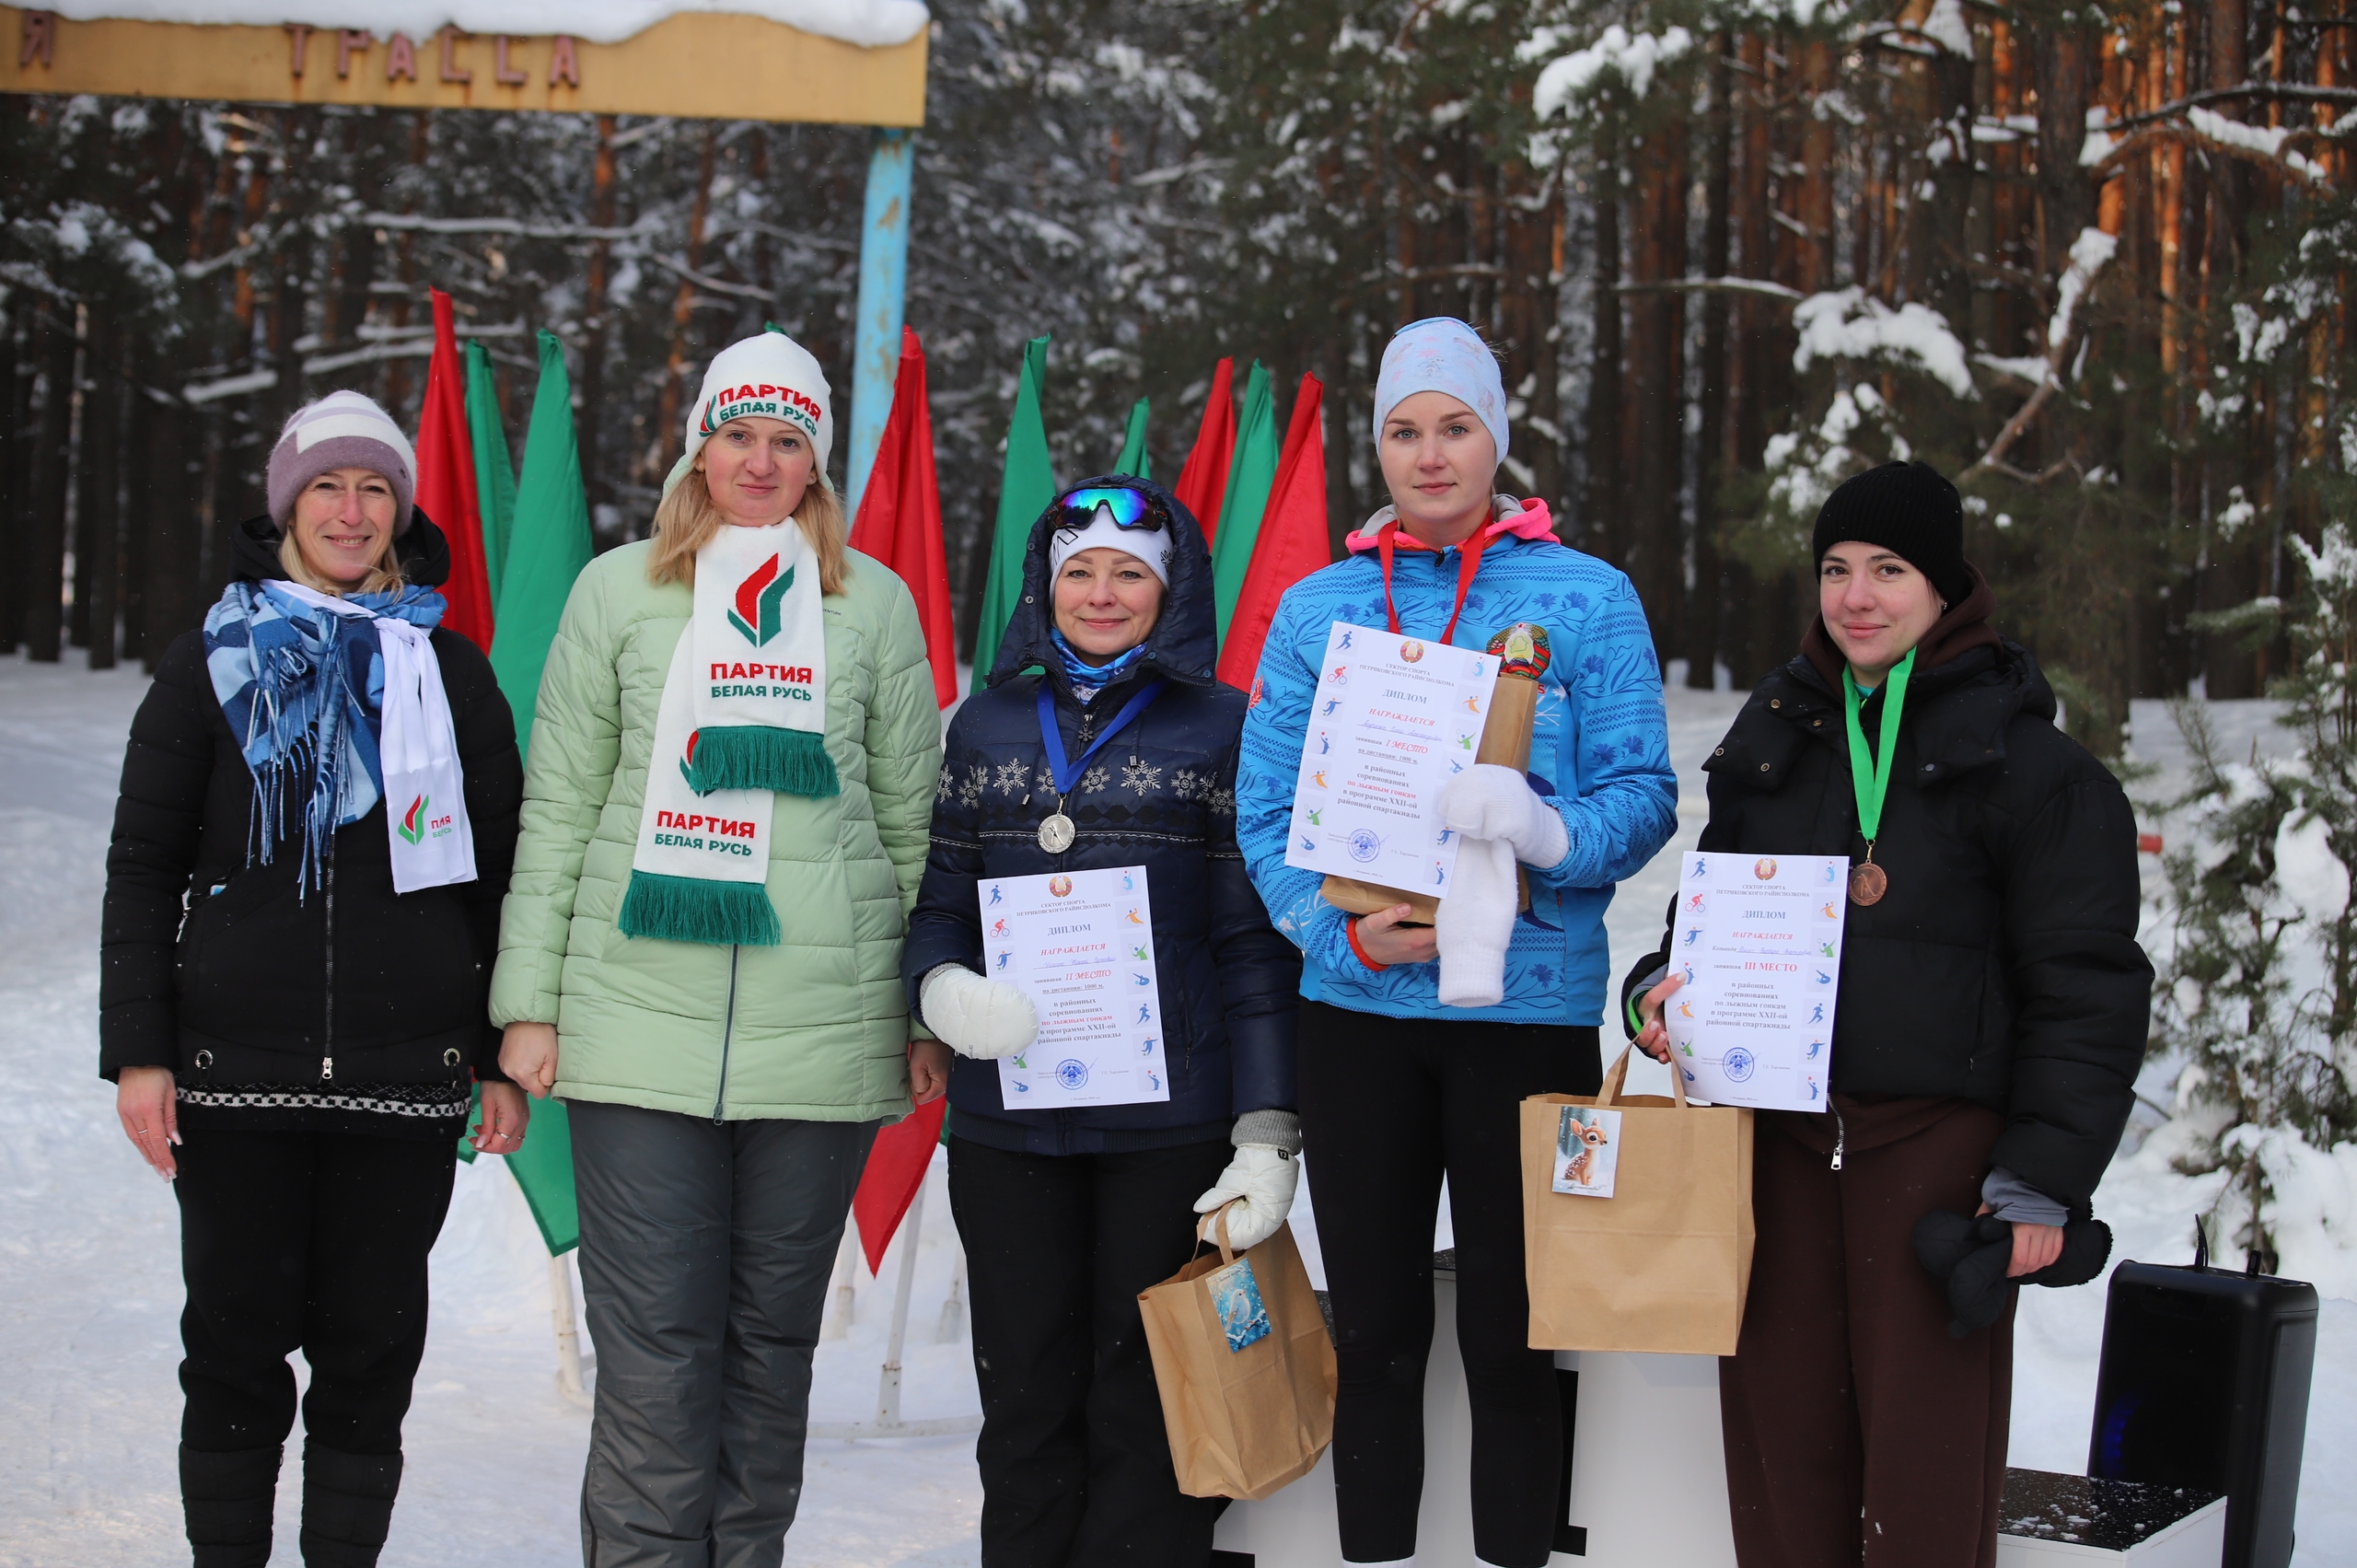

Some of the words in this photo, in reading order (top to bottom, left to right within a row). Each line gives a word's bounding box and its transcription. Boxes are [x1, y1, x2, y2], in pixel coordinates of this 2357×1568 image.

[719, 384, 821, 423] ПАРТИЯ
[719, 402, 776, 422] БЕЛАЯ
[783, 405, 818, 436] РУСЬ
[711, 663, 812, 684] ПАРТИЯ
[1359, 664, 1407, 678] ПЕТРИКОВСКОГО
[1386, 663, 1408, 671] СЕКТОР
[1408, 668, 1431, 676] СПОРТА
[711, 685, 767, 699] БЕЛАЯ
[772, 686, 812, 702] РУСЬ
[1382, 689, 1427, 704] ДИПЛОМ
[1368, 708, 1435, 726] НАГРАЖДАЕТСЯ
[1391, 740, 1428, 754] МЕСТО
[1370, 766, 1406, 778] районных
[1357, 773, 1410, 788] соревнованиях
[1356, 782, 1389, 794] лыжным
[1390, 789, 1417, 799] гонкам
[1349, 790, 1387, 803] программе
[1388, 797, 1417, 809] XXII-ой
[1337, 798, 1372, 809] районной
[1372, 805, 1421, 819] спартакиады
[656, 810, 755, 839] ПАРТИЯ
[655, 833, 703, 849] БЕЛАЯ
[708, 841, 752, 856] РУСЬ
[1016, 907, 1064, 917] ПЕТРИКОВСКОГО
[1742, 910, 1786, 919] ДИПЛОМ
[1047, 924, 1091, 936] ДИПЛОМ
[1732, 931, 1794, 940] НАГРАЖДАЕТСЯ
[1040, 943, 1106, 956] НАГРАЖДАЕТСЯ
[1744, 962, 1756, 970] III
[1759, 962, 1798, 972] МЕСТО
[1074, 970, 1111, 980] МЕСТО
[1060, 999, 1096, 1008] районных
[1049, 1007, 1103, 1017] соревнованиях
[1046, 1027, 1086, 1036] программе
[1087, 1022, 1116, 1031] XXII-ой
[1037, 1035, 1072, 1045] районной
[1074, 1032, 1121, 1042] спартакиады
